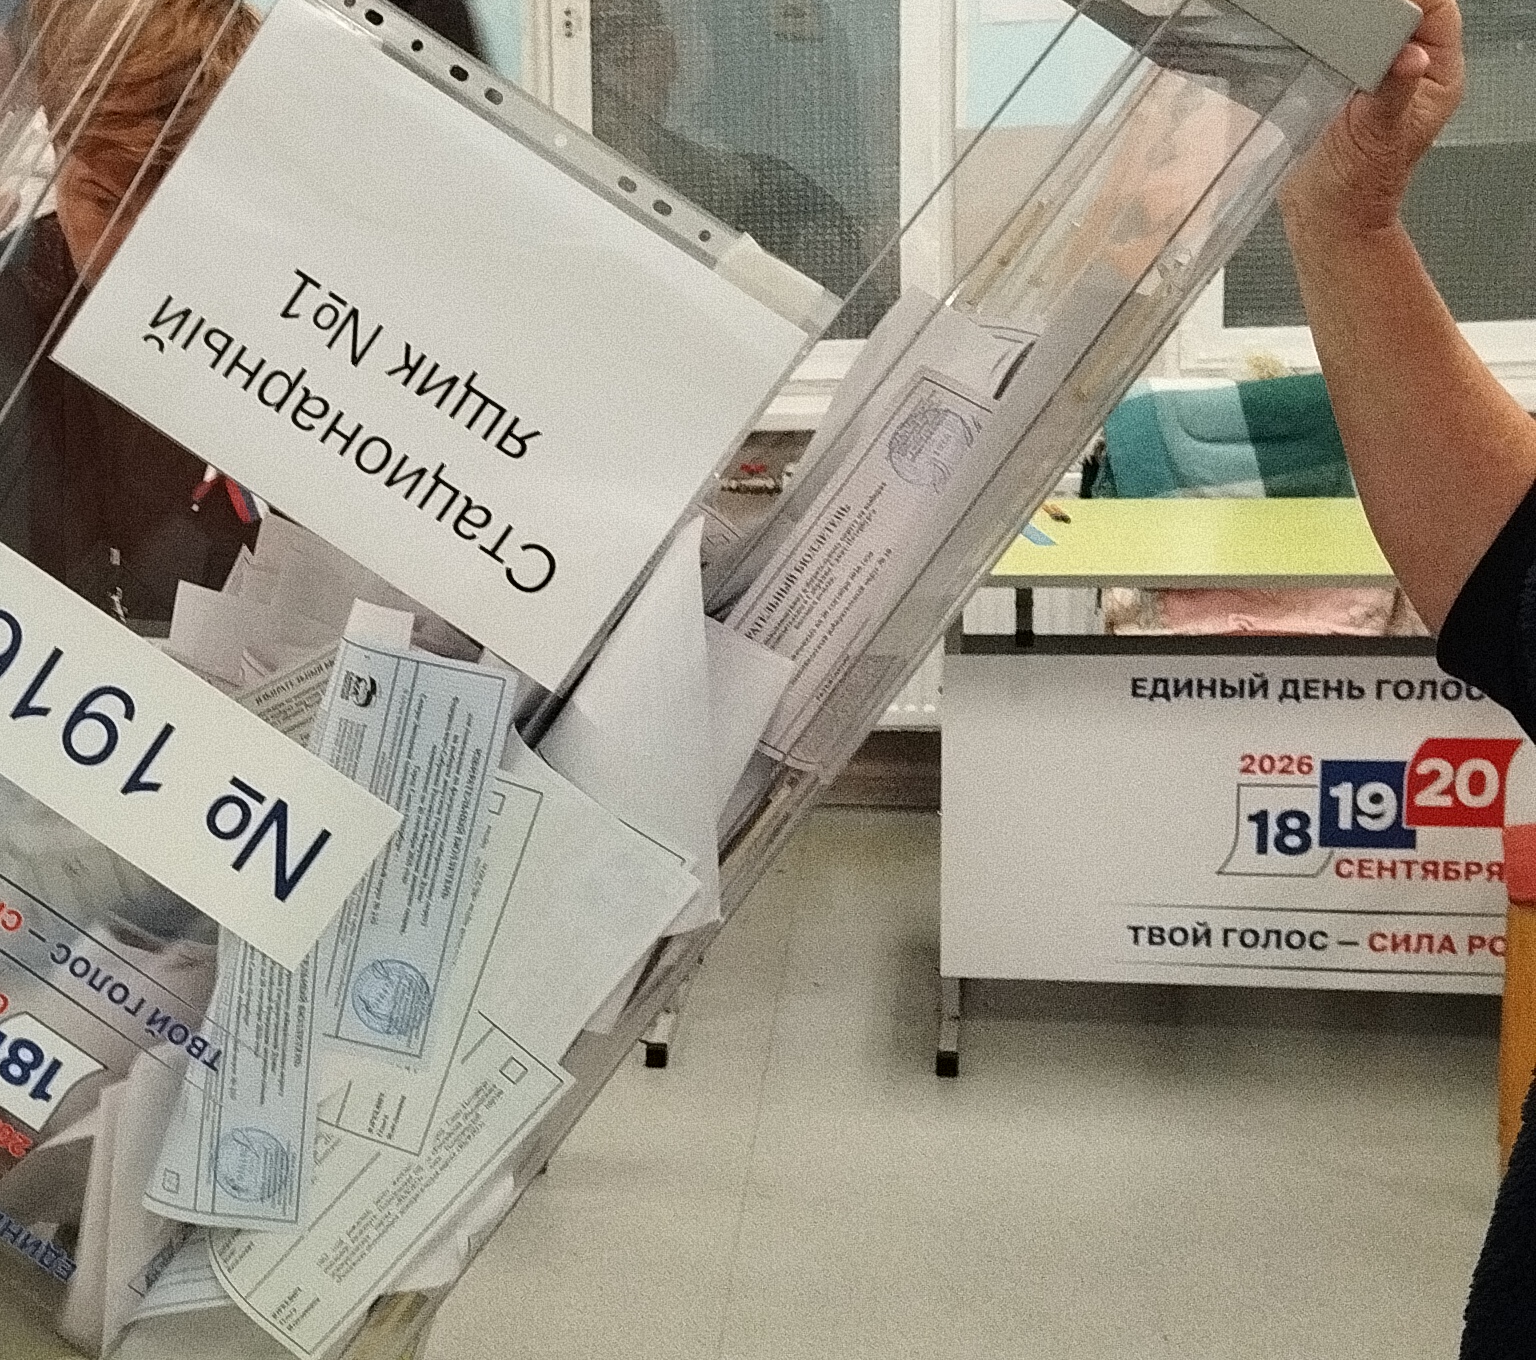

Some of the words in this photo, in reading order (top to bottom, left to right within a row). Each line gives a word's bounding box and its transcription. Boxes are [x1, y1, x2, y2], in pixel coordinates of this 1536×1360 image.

[280, 268, 384, 367] №1
[387, 342, 543, 461] ящик
[143, 295, 558, 594] Стационарный
[1130, 672, 1269, 703] ЕДИНЫЙ
[1278, 677, 1365, 703] ДЕНЬ
[1239, 753, 1314, 776] 2026
[205, 775, 332, 903] №
[1247, 808, 1312, 856] 18
[1329, 781, 1398, 832] 19
[1413, 758, 1500, 809] 20
[1334, 858, 1505, 883] СЕНТЯБРЯ
[1127, 921, 1212, 949] ТВОЙ
[1222, 927, 1329, 951] ГОЛОС
[1368, 931, 1457, 955] СИЛА
[49, 943, 144, 1014] ГОЛОС
[144, 1007, 223, 1072] ТВОЙ
